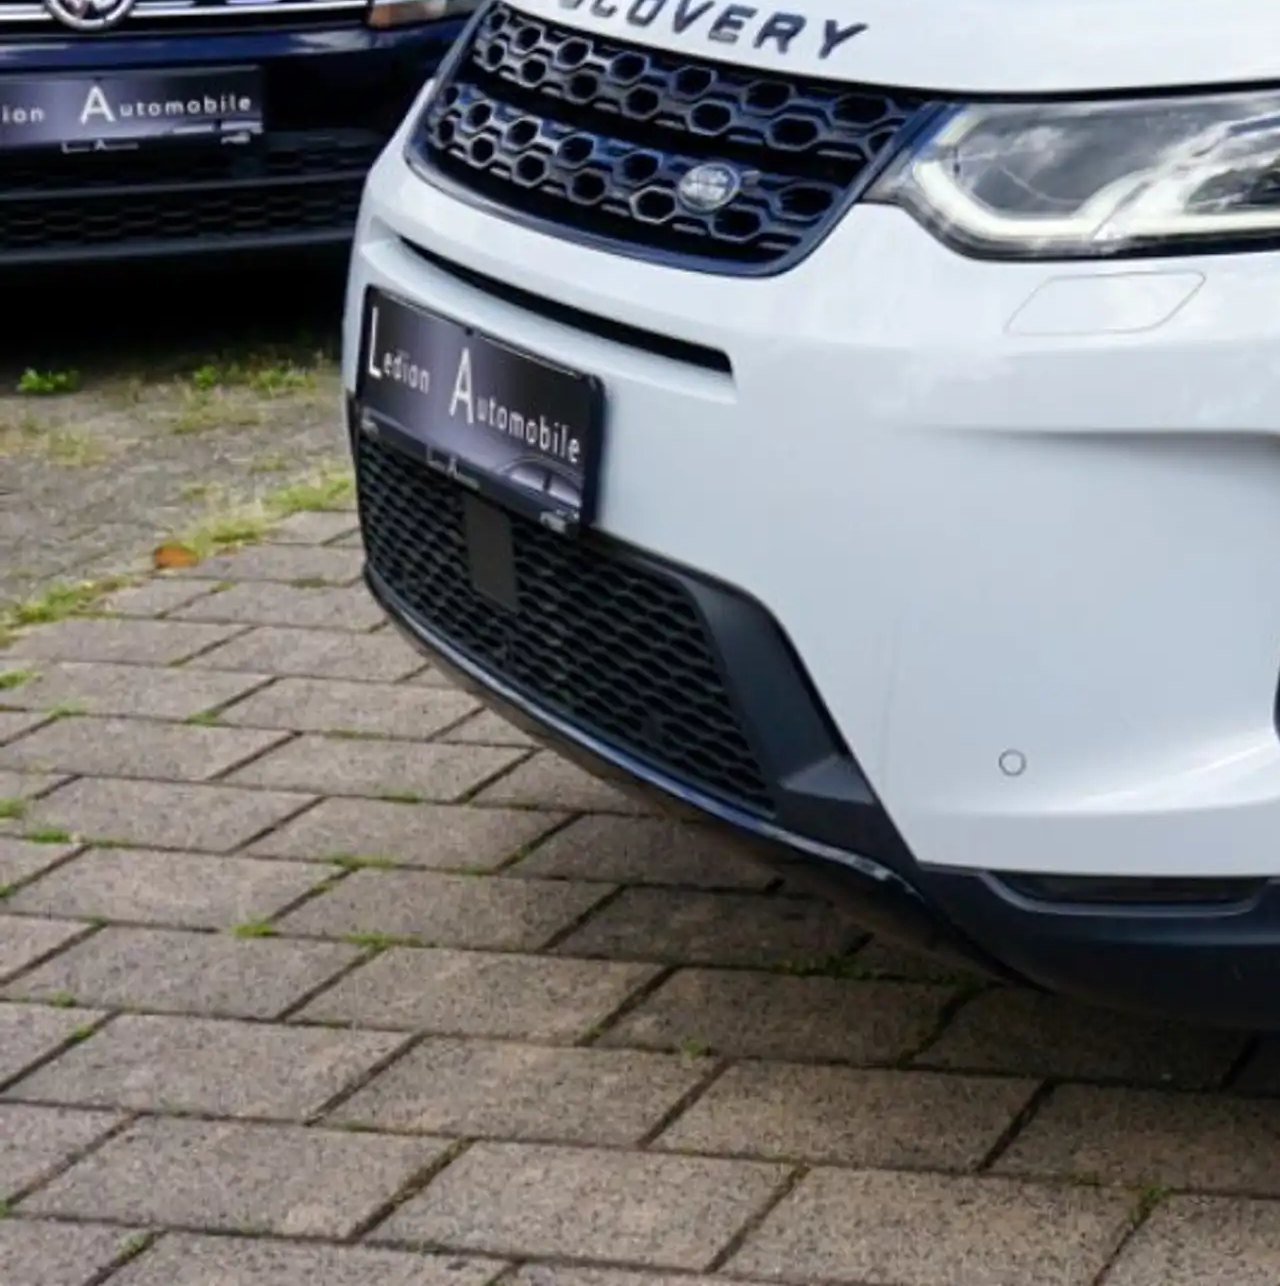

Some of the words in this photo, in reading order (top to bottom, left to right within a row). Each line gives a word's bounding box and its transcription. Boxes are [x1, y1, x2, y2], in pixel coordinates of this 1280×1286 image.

[1, 104, 45, 124] ion
[79, 85, 252, 126] Automobile
[368, 305, 431, 395] Ledion
[448, 346, 581, 464] Automobile
